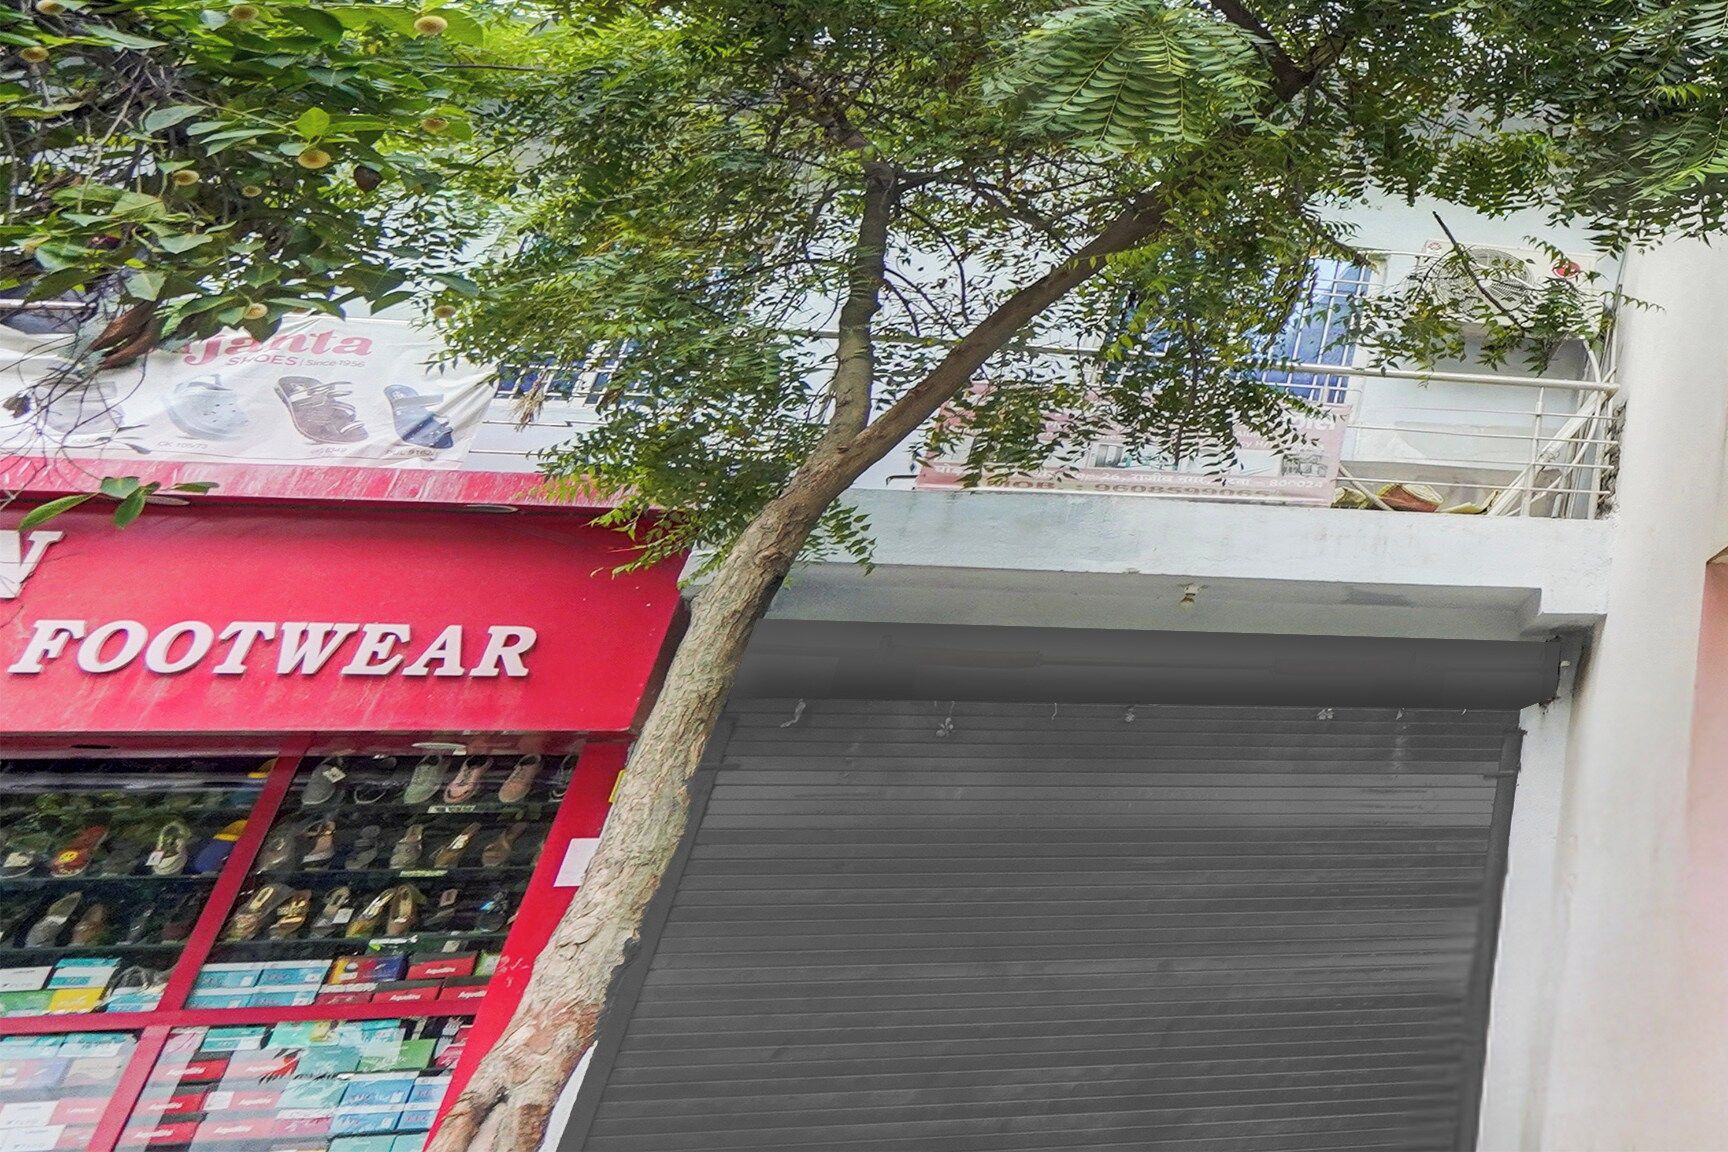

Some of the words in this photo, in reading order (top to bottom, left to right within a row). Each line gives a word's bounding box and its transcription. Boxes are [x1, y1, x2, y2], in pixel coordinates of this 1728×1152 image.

[226, 353, 298, 366] SHOES
[306, 359, 337, 367] Since
[7, 619, 537, 678] FOOTWEAR
